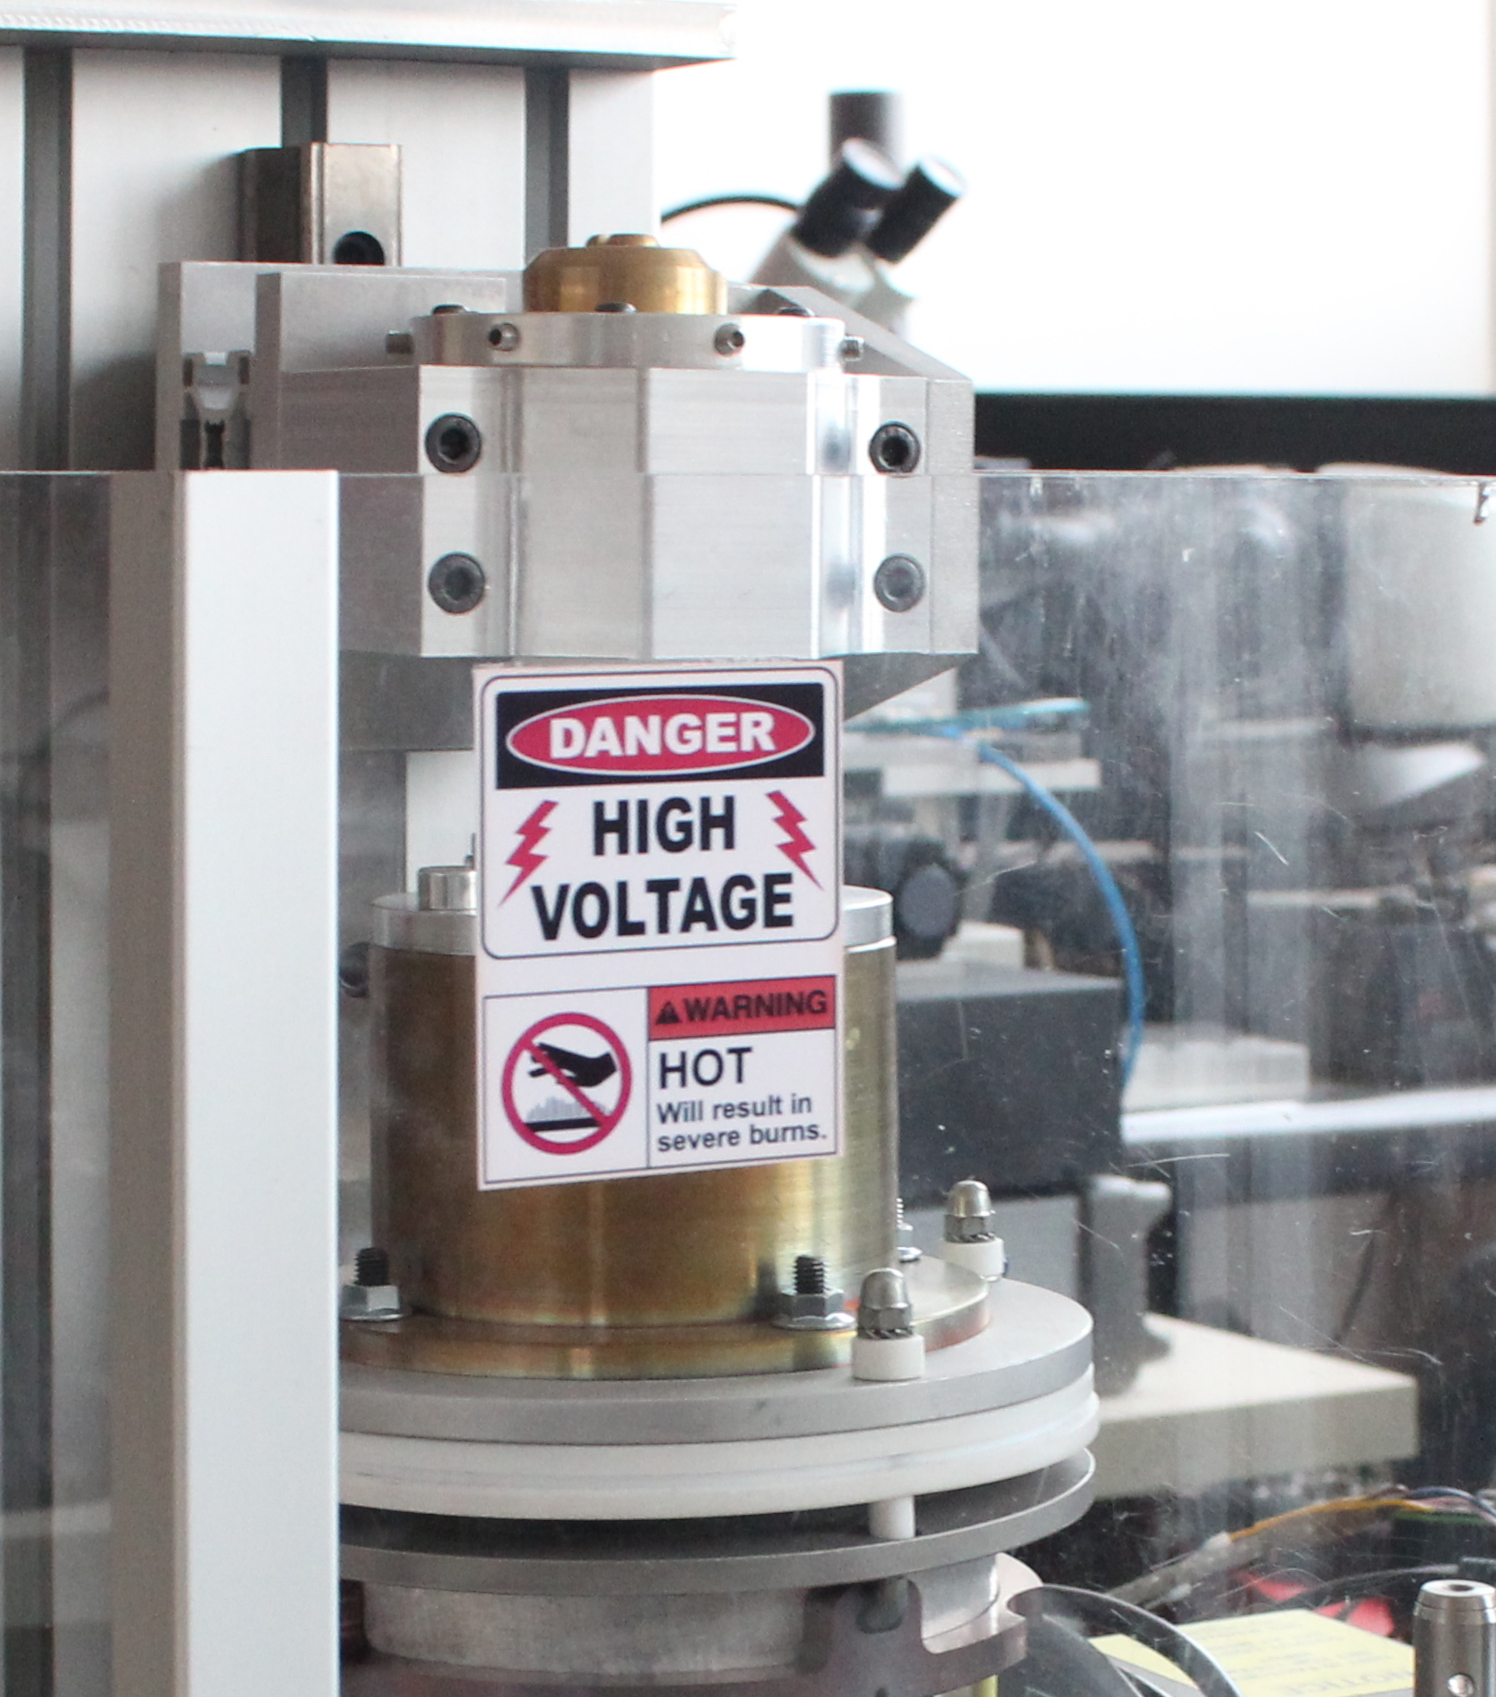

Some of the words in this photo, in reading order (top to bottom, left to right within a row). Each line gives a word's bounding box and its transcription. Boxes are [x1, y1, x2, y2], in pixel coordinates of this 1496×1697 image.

[548, 710, 778, 760] DANGER
[591, 794, 737, 857] HIGH
[530, 871, 795, 942] VOLTAGE
[683, 989, 828, 1023] WARNING
[659, 1046, 754, 1090] HOT
[656, 1100, 704, 1124] Will
[712, 1095, 783, 1120] result
[791, 1093, 812, 1114] in
[657, 1129, 741, 1152] severe
[749, 1122, 827, 1145] burns.
